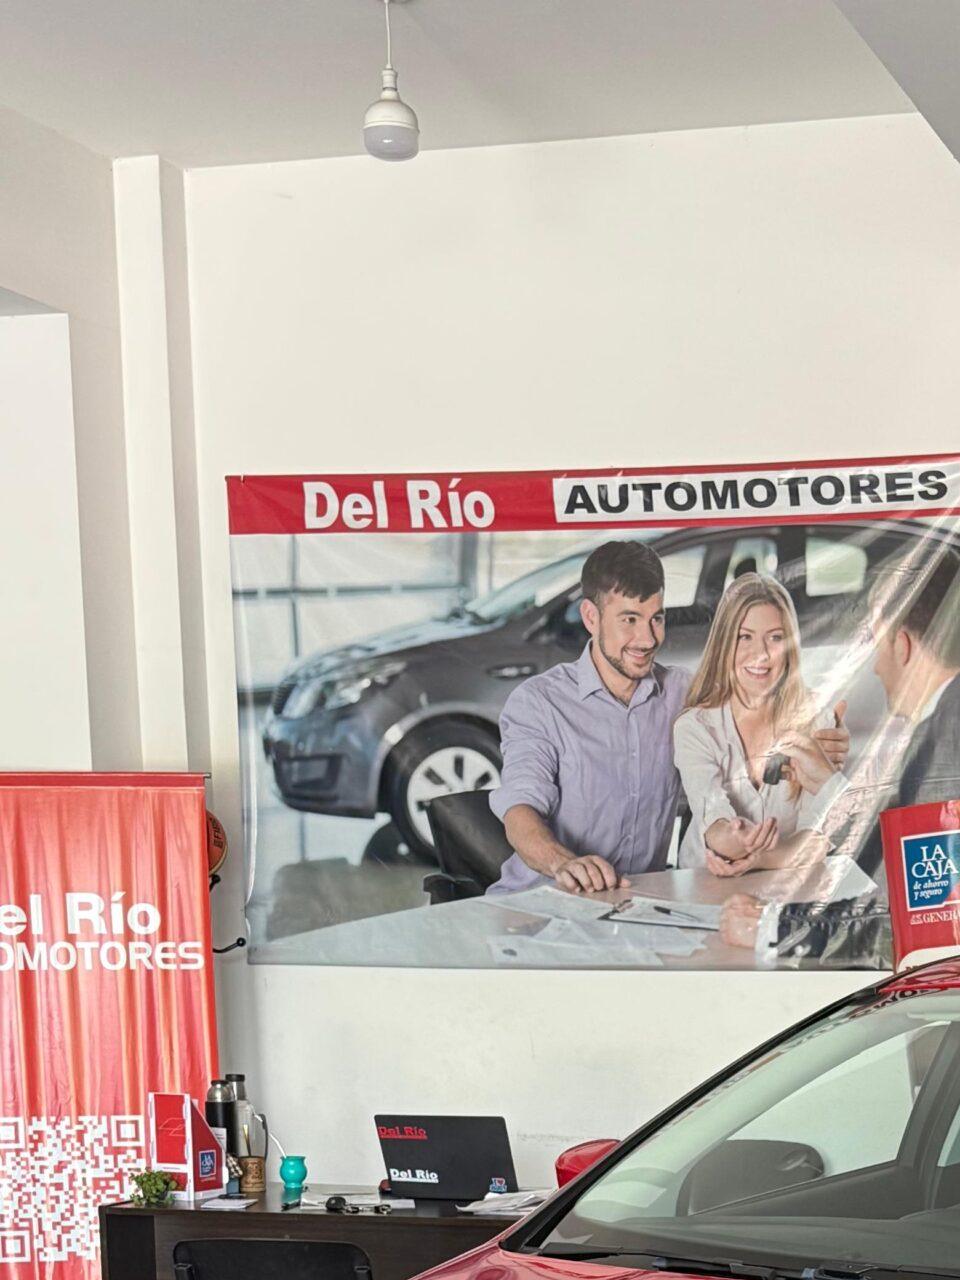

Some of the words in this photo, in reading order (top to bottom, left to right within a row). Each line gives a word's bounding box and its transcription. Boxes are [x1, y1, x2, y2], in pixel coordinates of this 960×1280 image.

[563, 469, 949, 515] AUTOMOTORES
[302, 480, 389, 529] Del
[406, 478, 495, 528] Río
[920, 844, 947, 862] LA
[911, 858, 960, 880] CAJA
[65, 891, 161, 935] Río
[378, 1126, 400, 1136] Del
[389, 1168, 412, 1179] Del
